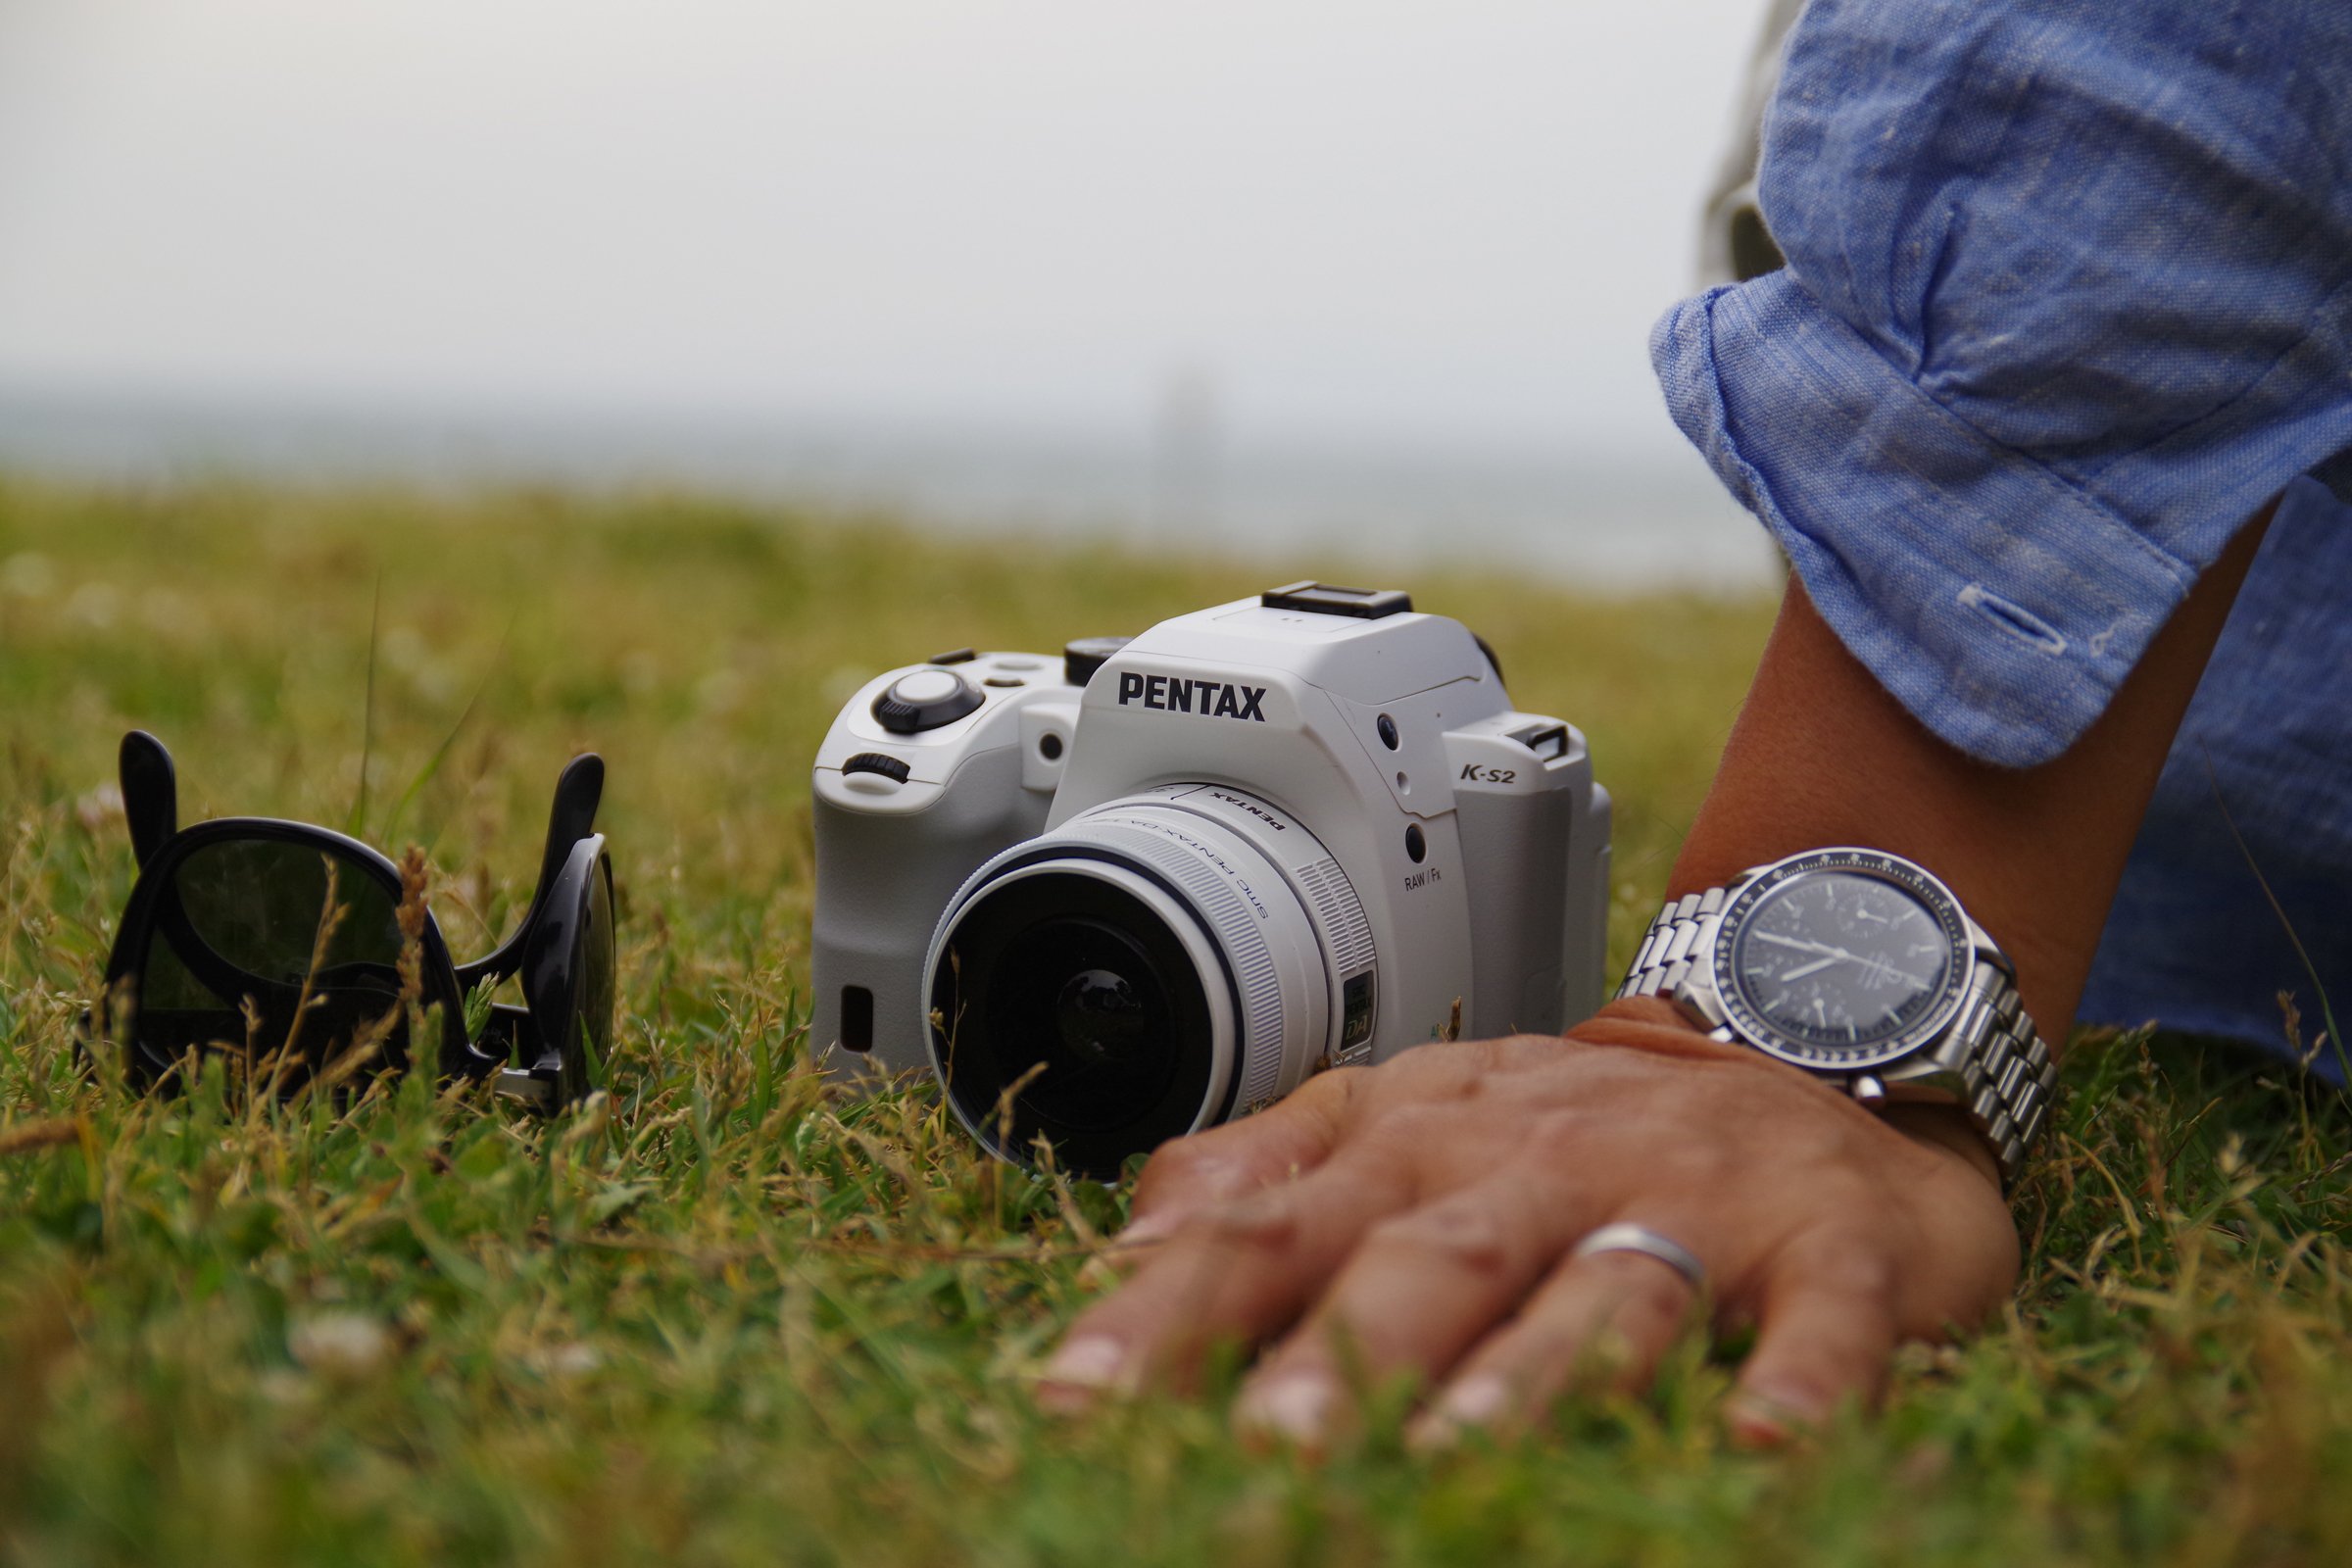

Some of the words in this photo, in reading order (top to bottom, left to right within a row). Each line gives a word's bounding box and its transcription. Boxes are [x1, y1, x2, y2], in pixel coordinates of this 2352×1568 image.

[1118, 671, 1266, 722] PENTAX
[1460, 763, 1517, 784] K-S2
[1208, 791, 1286, 832] PENTAX
[1404, 871, 1426, 892] RAW
